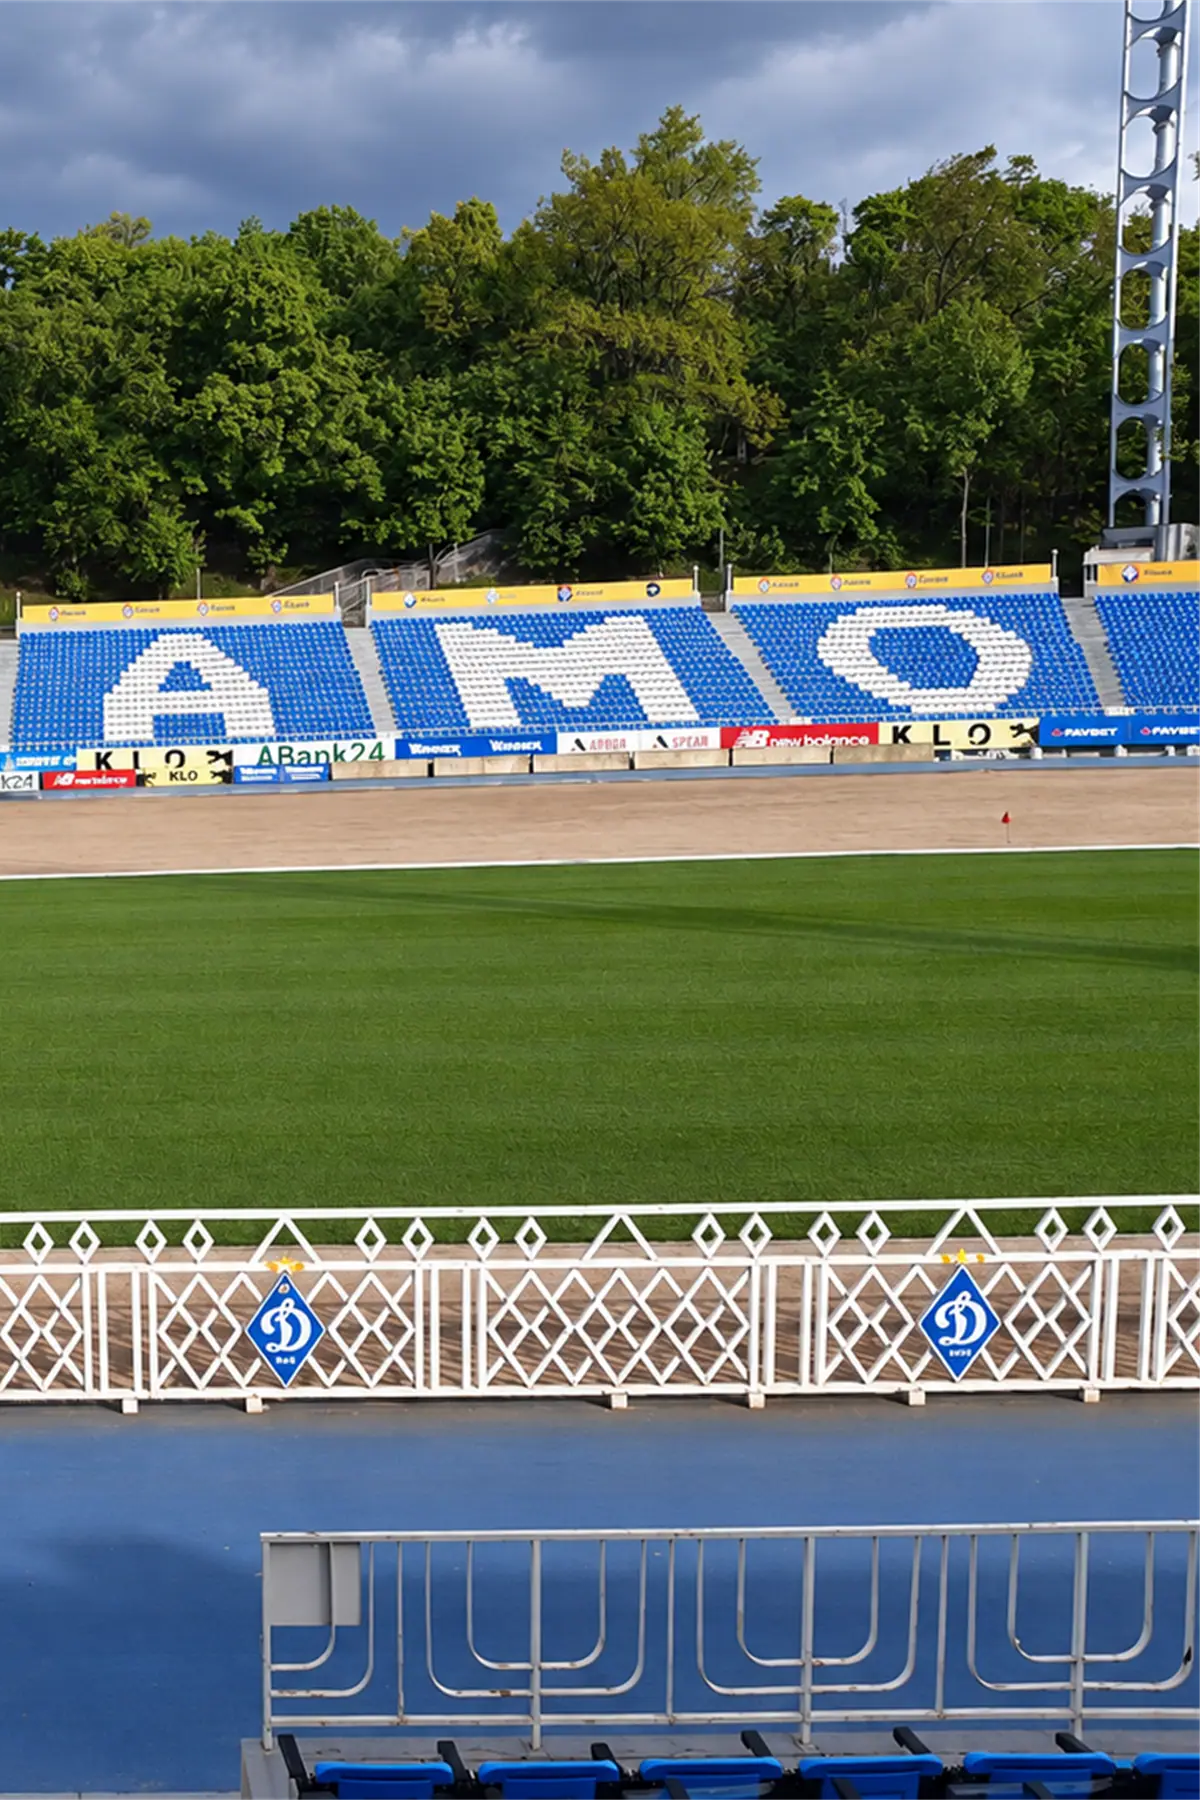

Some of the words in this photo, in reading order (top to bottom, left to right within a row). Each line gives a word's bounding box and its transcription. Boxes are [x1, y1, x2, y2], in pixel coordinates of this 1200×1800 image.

[803, 732, 870, 746] balance
[892, 723, 991, 746] KLO
[257, 741, 386, 766] ABank24
[169, 770, 198, 782] KLO
